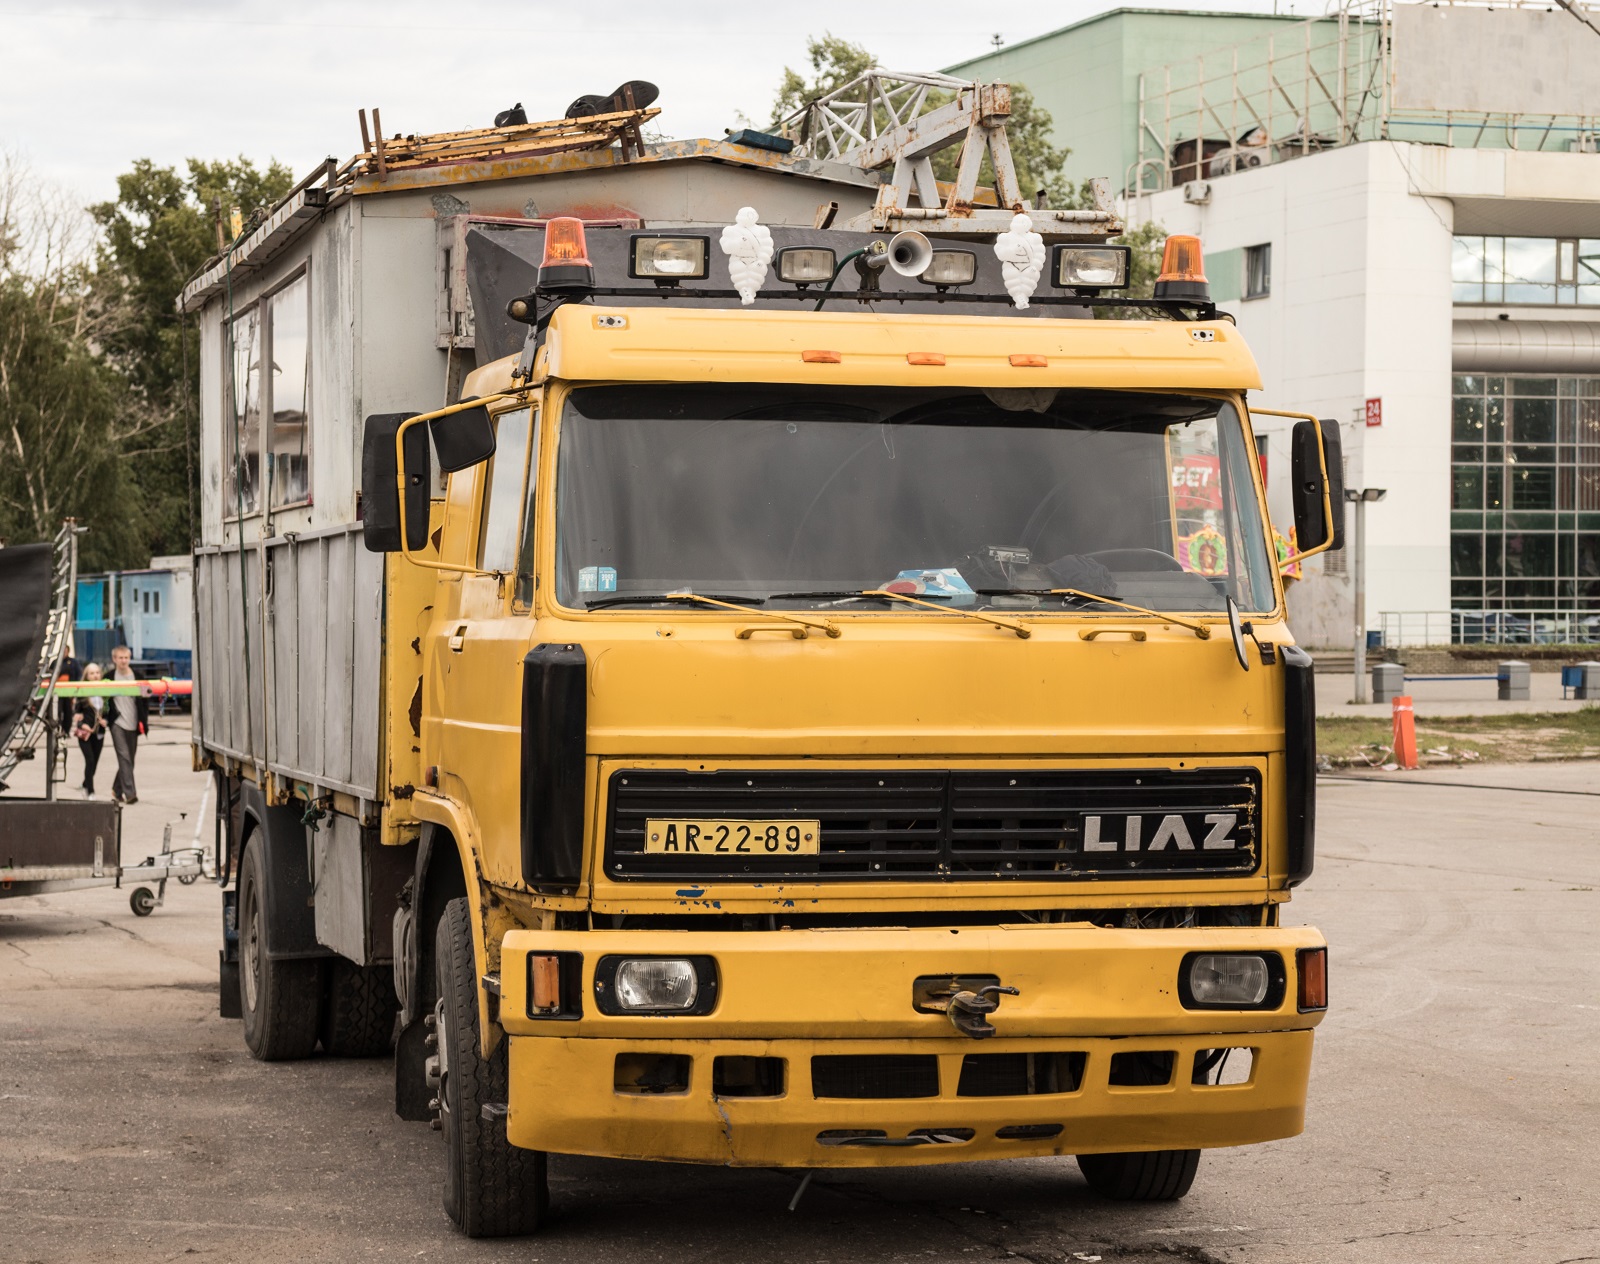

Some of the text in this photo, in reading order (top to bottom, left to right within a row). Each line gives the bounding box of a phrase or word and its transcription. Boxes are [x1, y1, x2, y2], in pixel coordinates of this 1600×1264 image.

[1368, 401, 1380, 416] 24
[664, 823, 800, 853] AR-22-89
[1083, 813, 1237, 852] LIAZ
